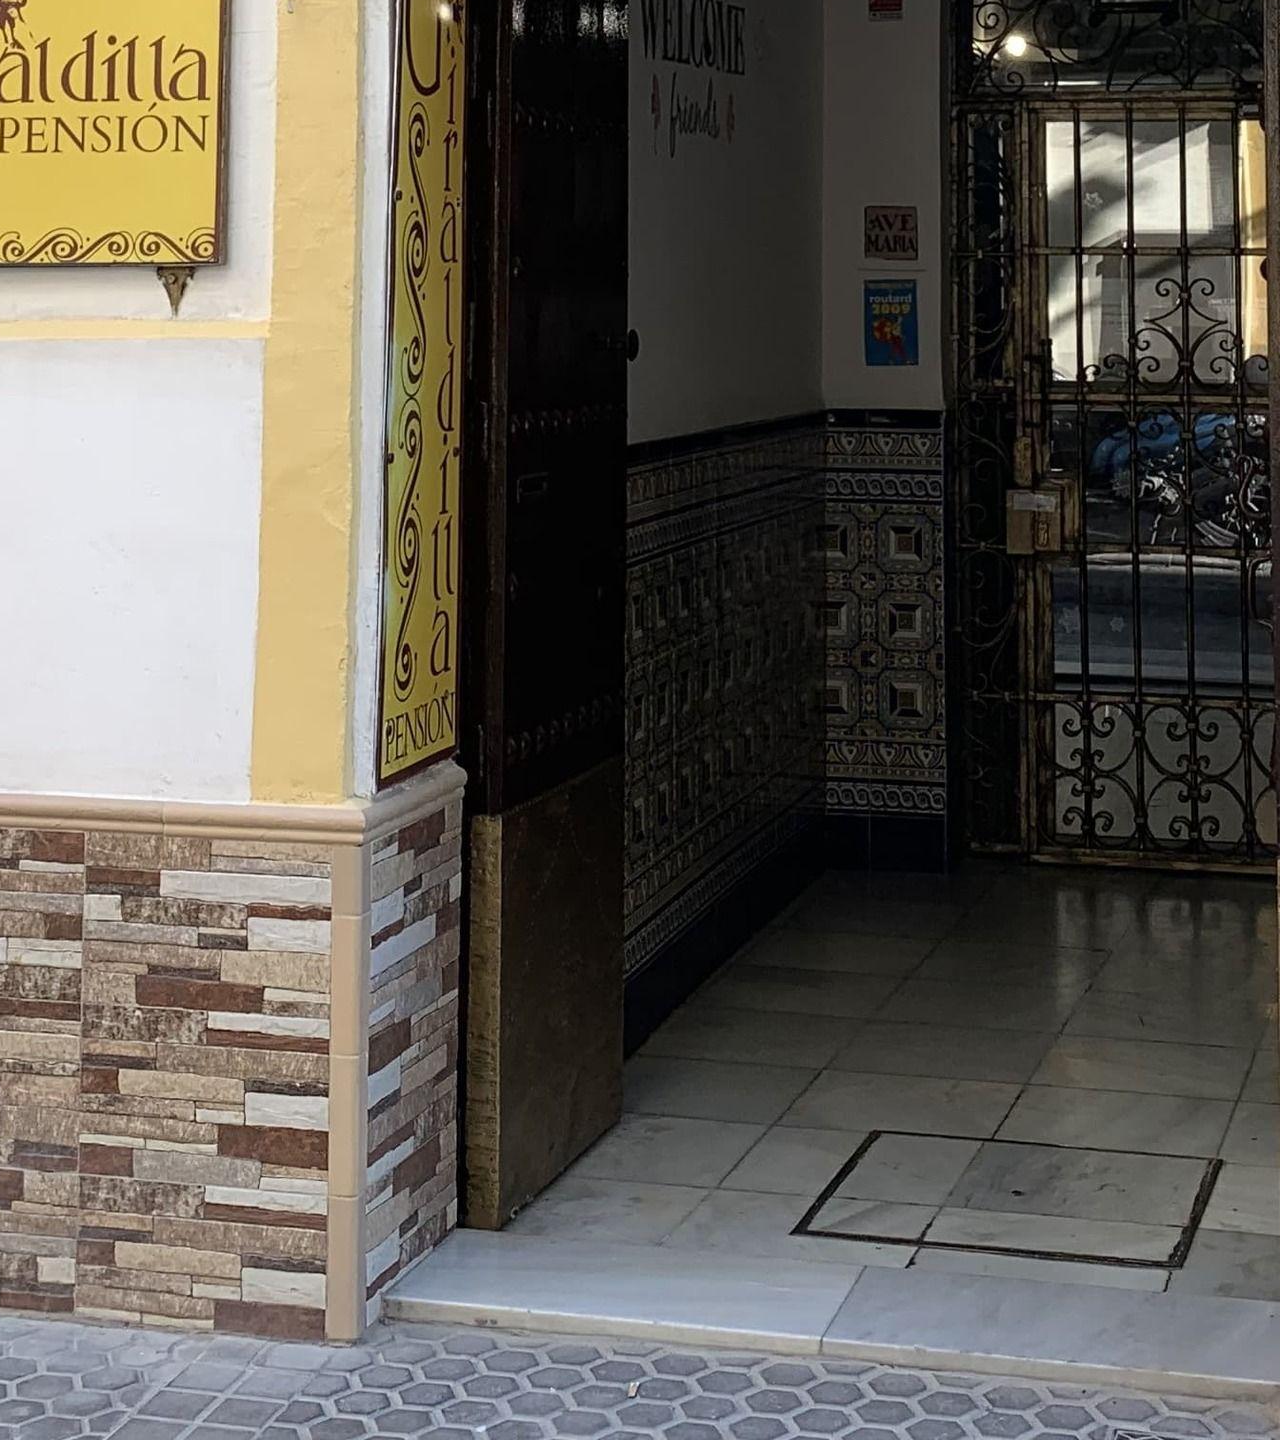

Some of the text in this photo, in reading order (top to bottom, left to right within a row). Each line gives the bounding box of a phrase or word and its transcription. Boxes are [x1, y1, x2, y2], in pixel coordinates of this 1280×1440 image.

[868, 213, 914, 231] AVE
[869, 293, 913, 304] routard
[385, 681, 457, 765] PENSIÓN
